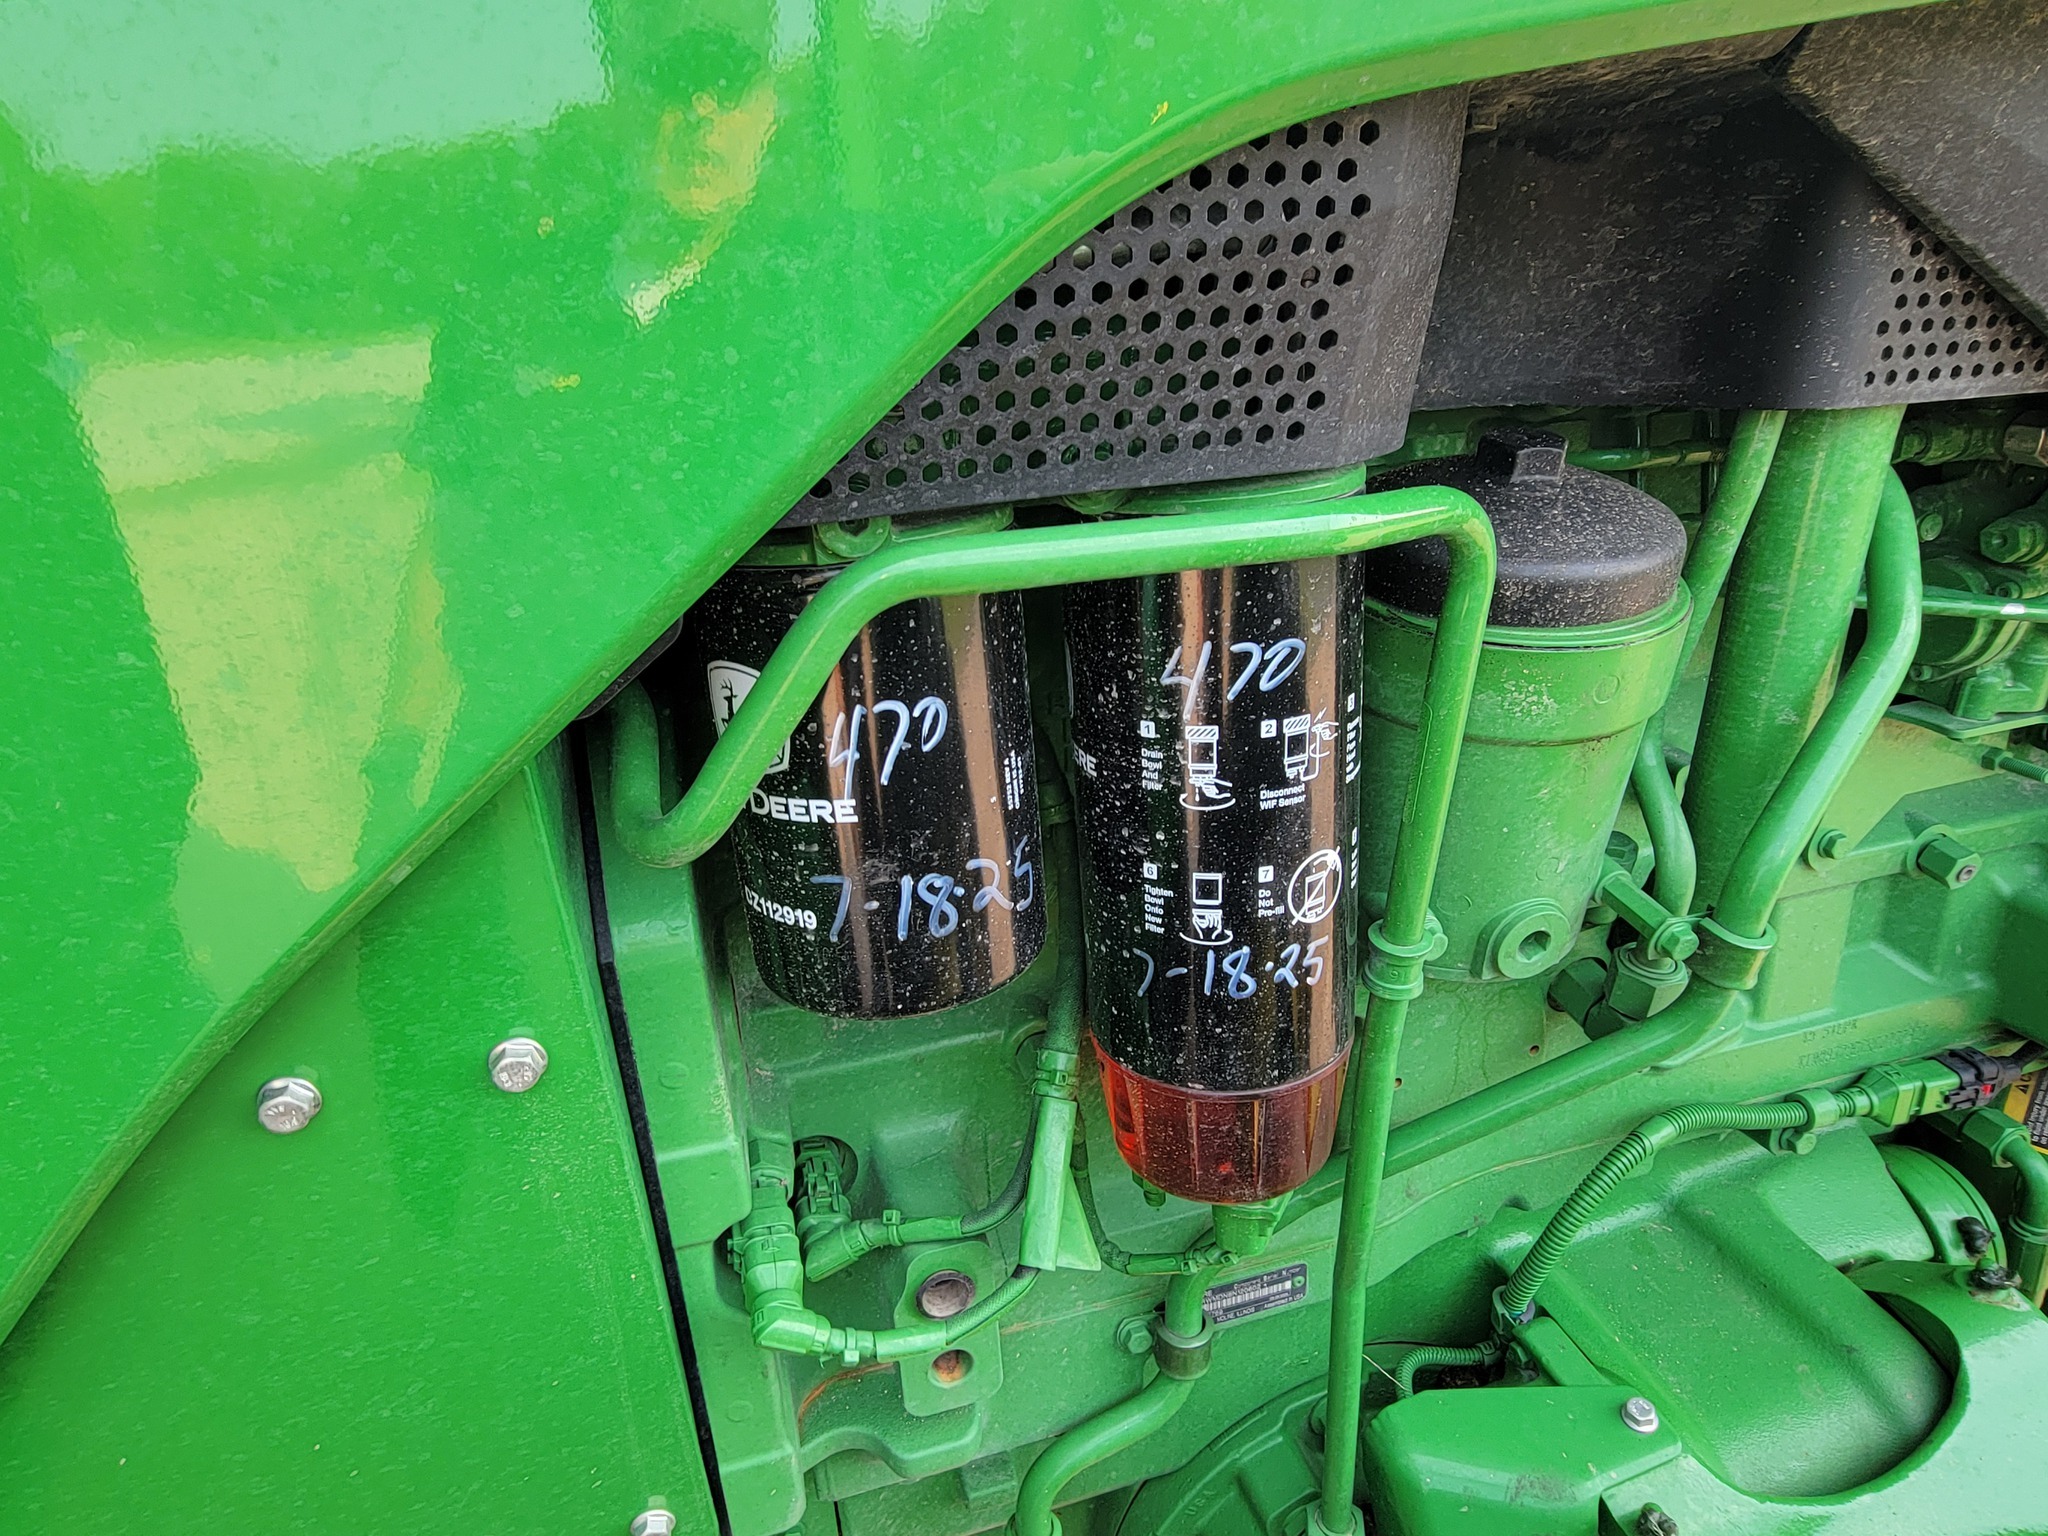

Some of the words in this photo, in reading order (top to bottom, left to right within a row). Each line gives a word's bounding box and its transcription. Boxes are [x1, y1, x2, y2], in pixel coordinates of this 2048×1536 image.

[1160, 638, 1306, 722] 470
[829, 696, 948, 801] 470
[1141, 747, 1163, 760] Drain
[1141, 758, 1163, 771] Bowl
[1141, 769, 1159, 780] And
[1142, 778, 1163, 791] Filter
[1260, 783, 1305, 800] Disconnect
[751, 787, 859, 823] DEERE
[1260, 799, 1277, 810] WIF
[1278, 795, 1306, 807] Sensor
[1144, 884, 1174, 898] Tighten
[1258, 889, 1271, 898] Do
[1144, 893, 1164, 905] Bowl
[1258, 898, 1273, 908] Not
[1144, 904, 1164, 915] Onto
[1258, 905, 1285, 918] Pre-fill
[1144, 913, 1162, 924] New
[1145, 922, 1165, 935] Filter
